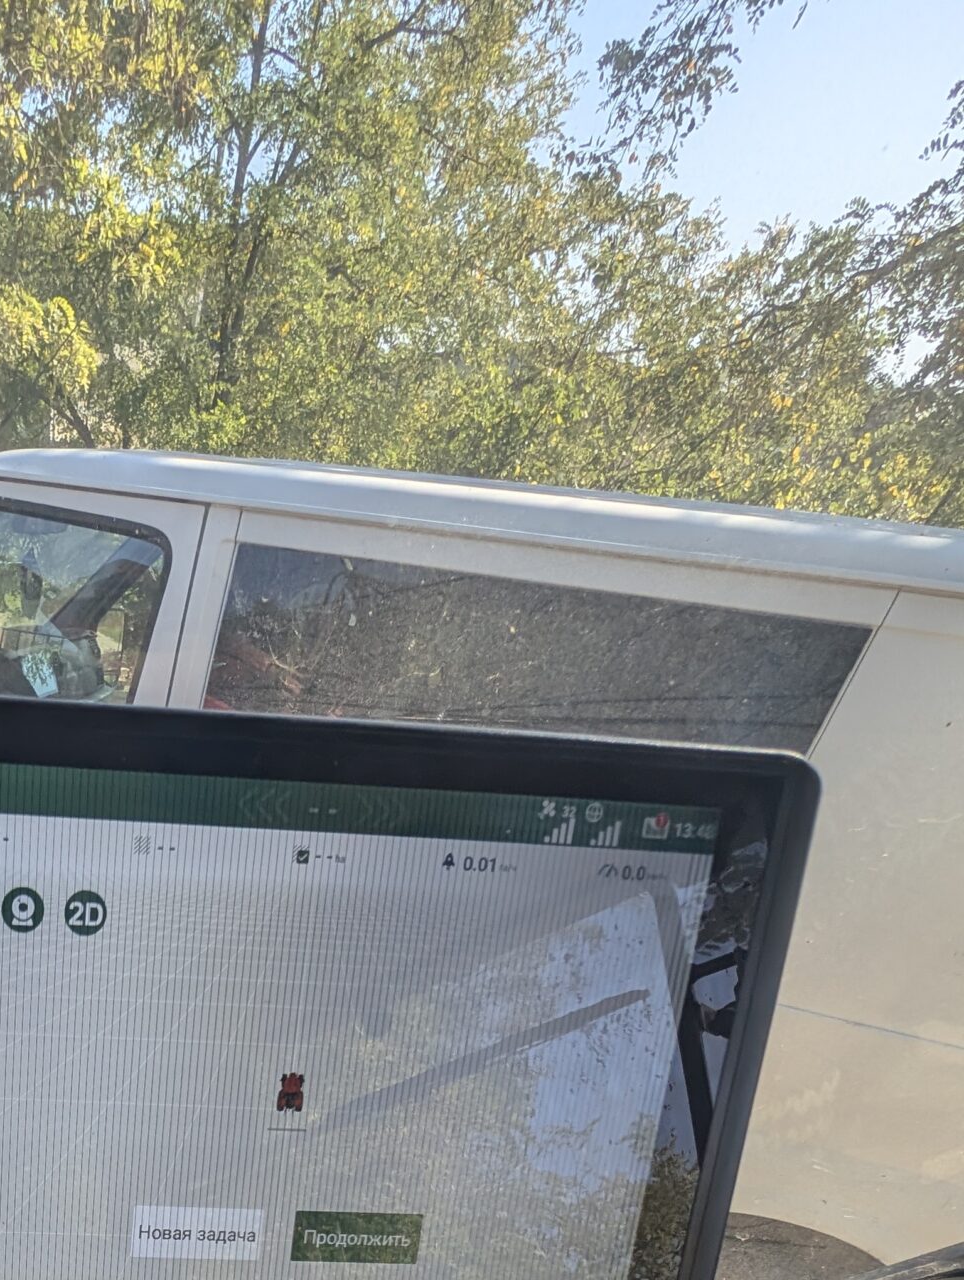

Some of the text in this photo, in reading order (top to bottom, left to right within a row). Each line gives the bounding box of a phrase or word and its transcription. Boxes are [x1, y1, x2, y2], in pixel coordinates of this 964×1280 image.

[463, 856, 496, 873] 0.01
[622, 865, 646, 881] 0.0
[68, 901, 105, 928] 2D
[138, 1224, 257, 1245] Новая задача
[302, 1229, 411, 1249] Продолжить
